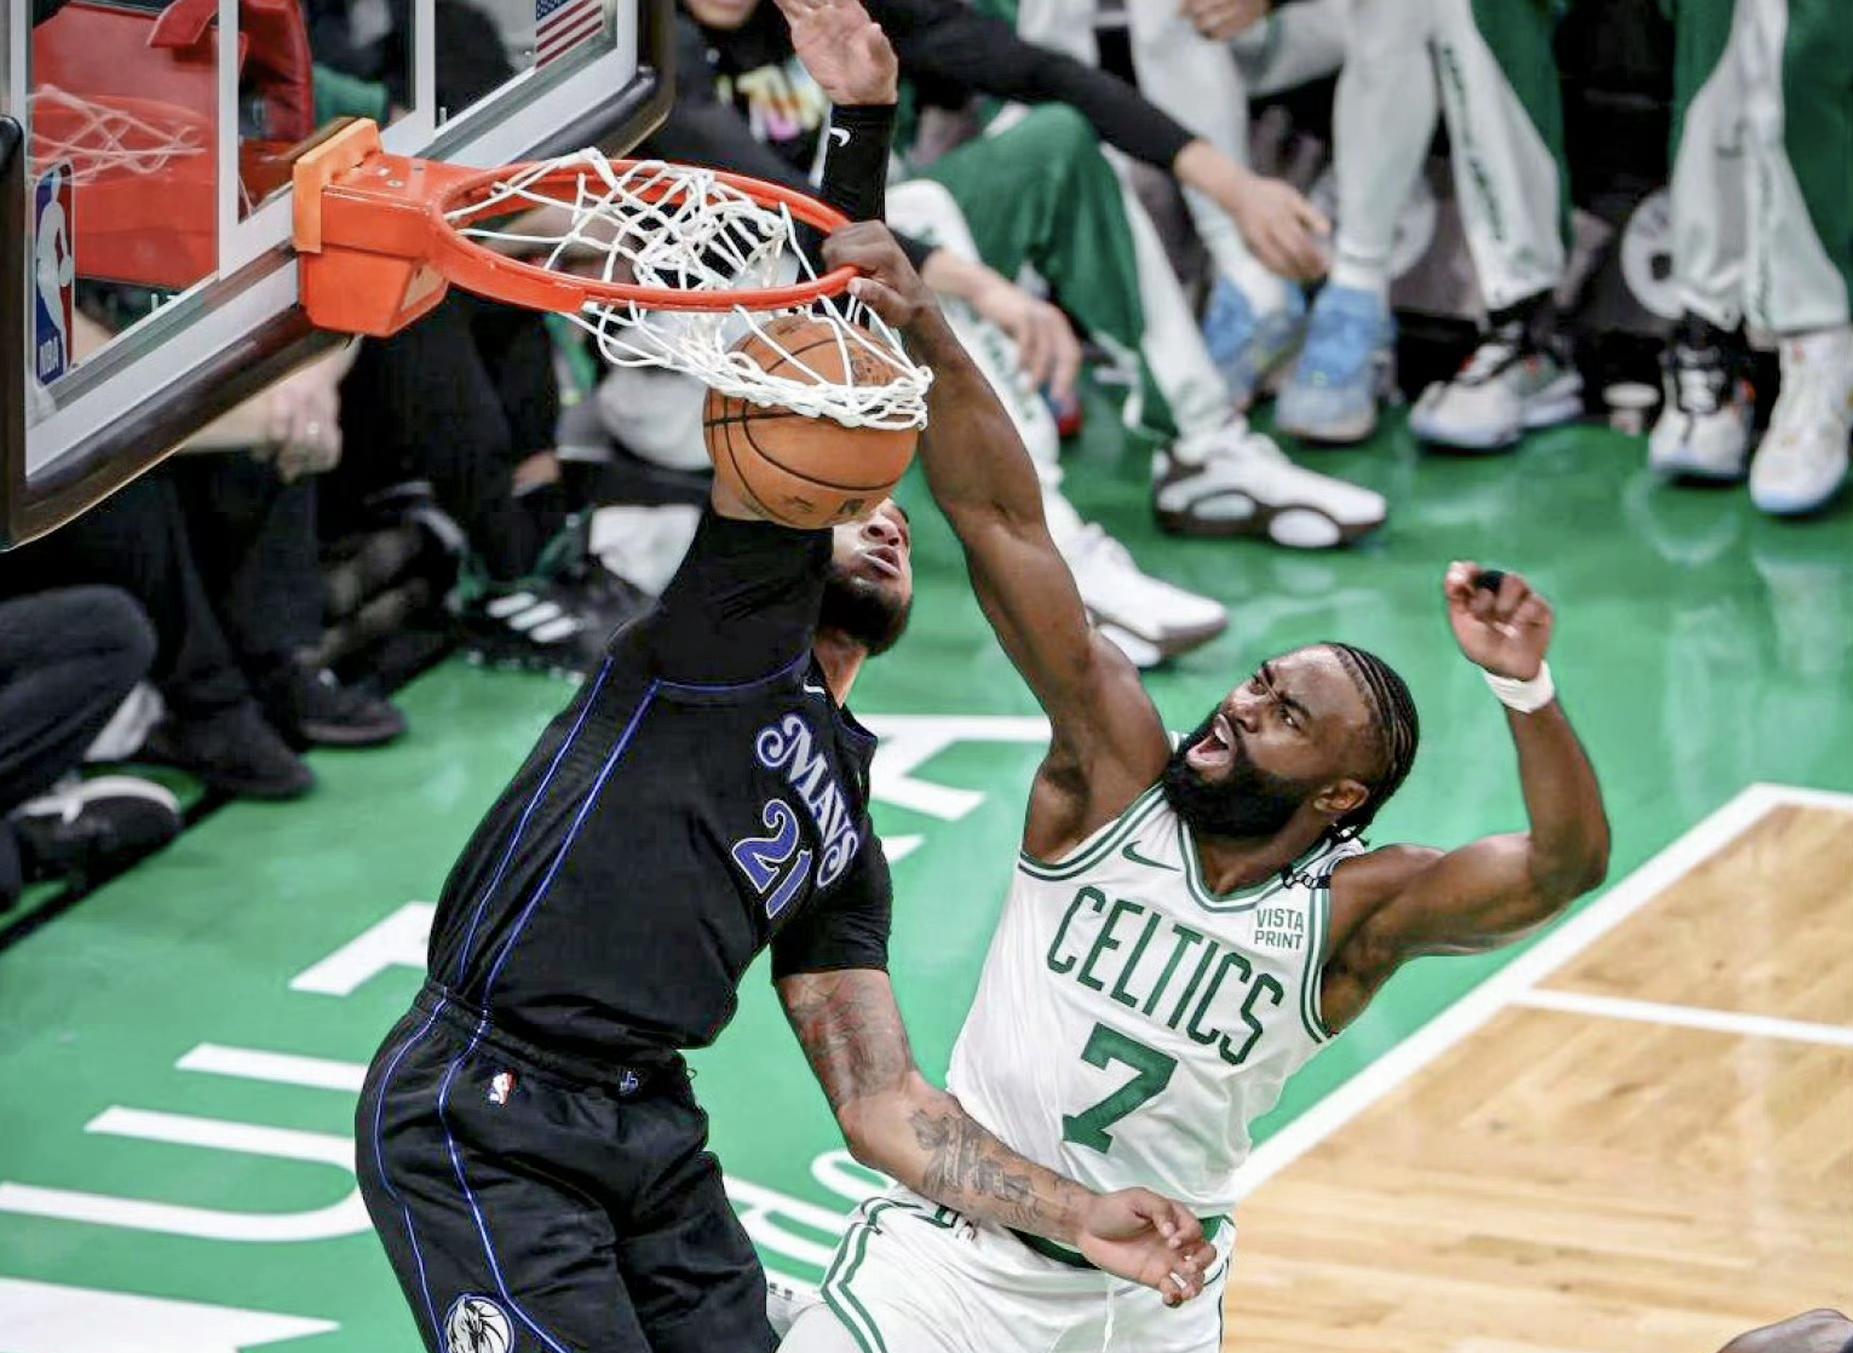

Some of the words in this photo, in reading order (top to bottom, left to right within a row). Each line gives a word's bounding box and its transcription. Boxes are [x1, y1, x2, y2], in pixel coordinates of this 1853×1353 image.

[732, 799, 812, 919] 21
[757, 715, 858, 888] MAVS
[1047, 885, 1284, 1065] CELTICS
[1253, 930, 1303, 951] PRINT
[1256, 907, 1304, 933] VISTA
[1062, 1022, 1178, 1154] 7
